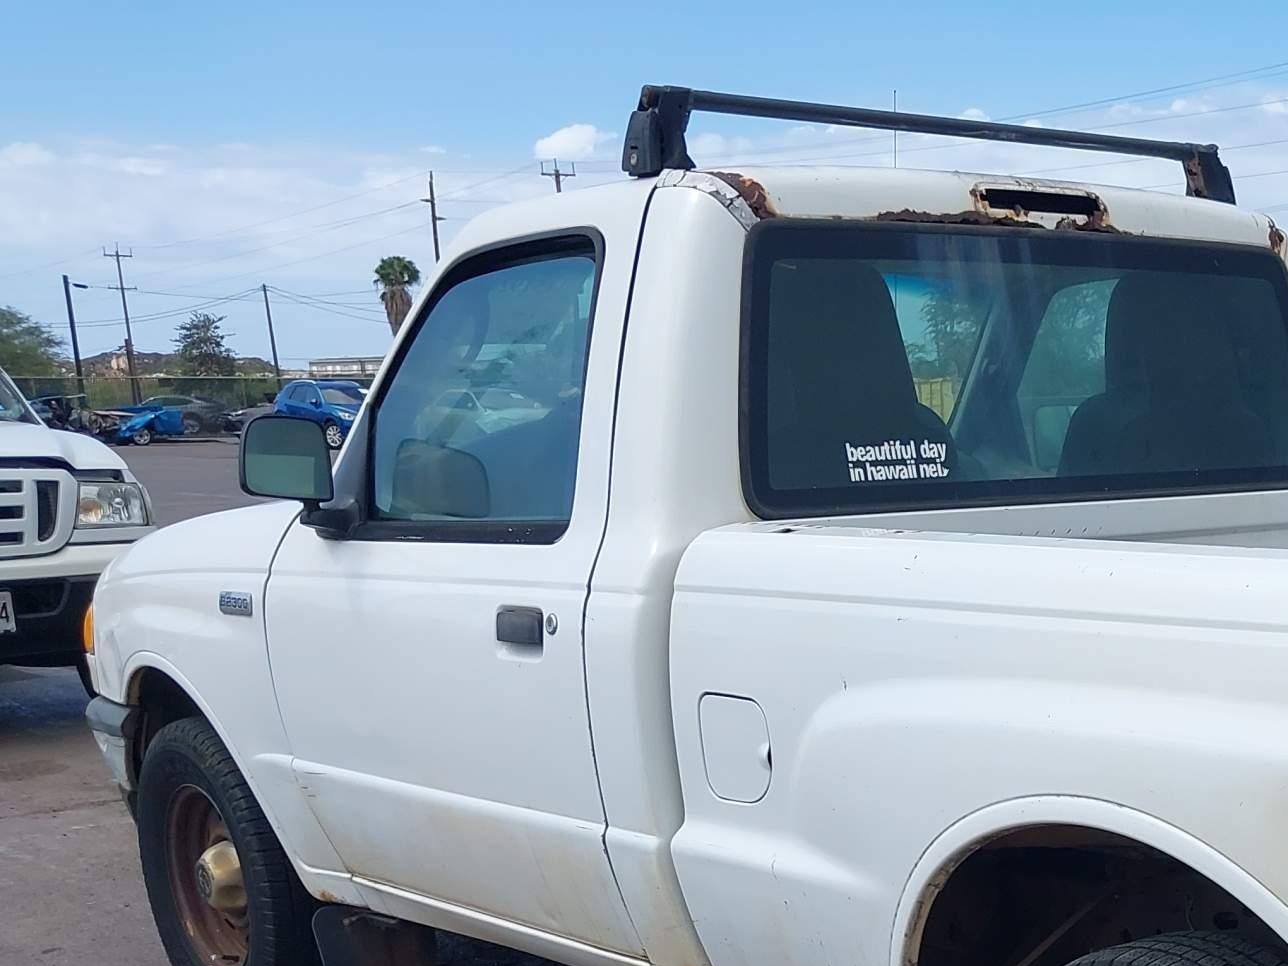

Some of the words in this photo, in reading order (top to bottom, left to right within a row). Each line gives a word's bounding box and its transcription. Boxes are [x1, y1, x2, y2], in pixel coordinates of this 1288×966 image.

[845, 440, 917, 461] beautiful
[920, 440, 946, 461] day
[848, 463, 865, 481] in
[865, 460, 917, 480] hawaii
